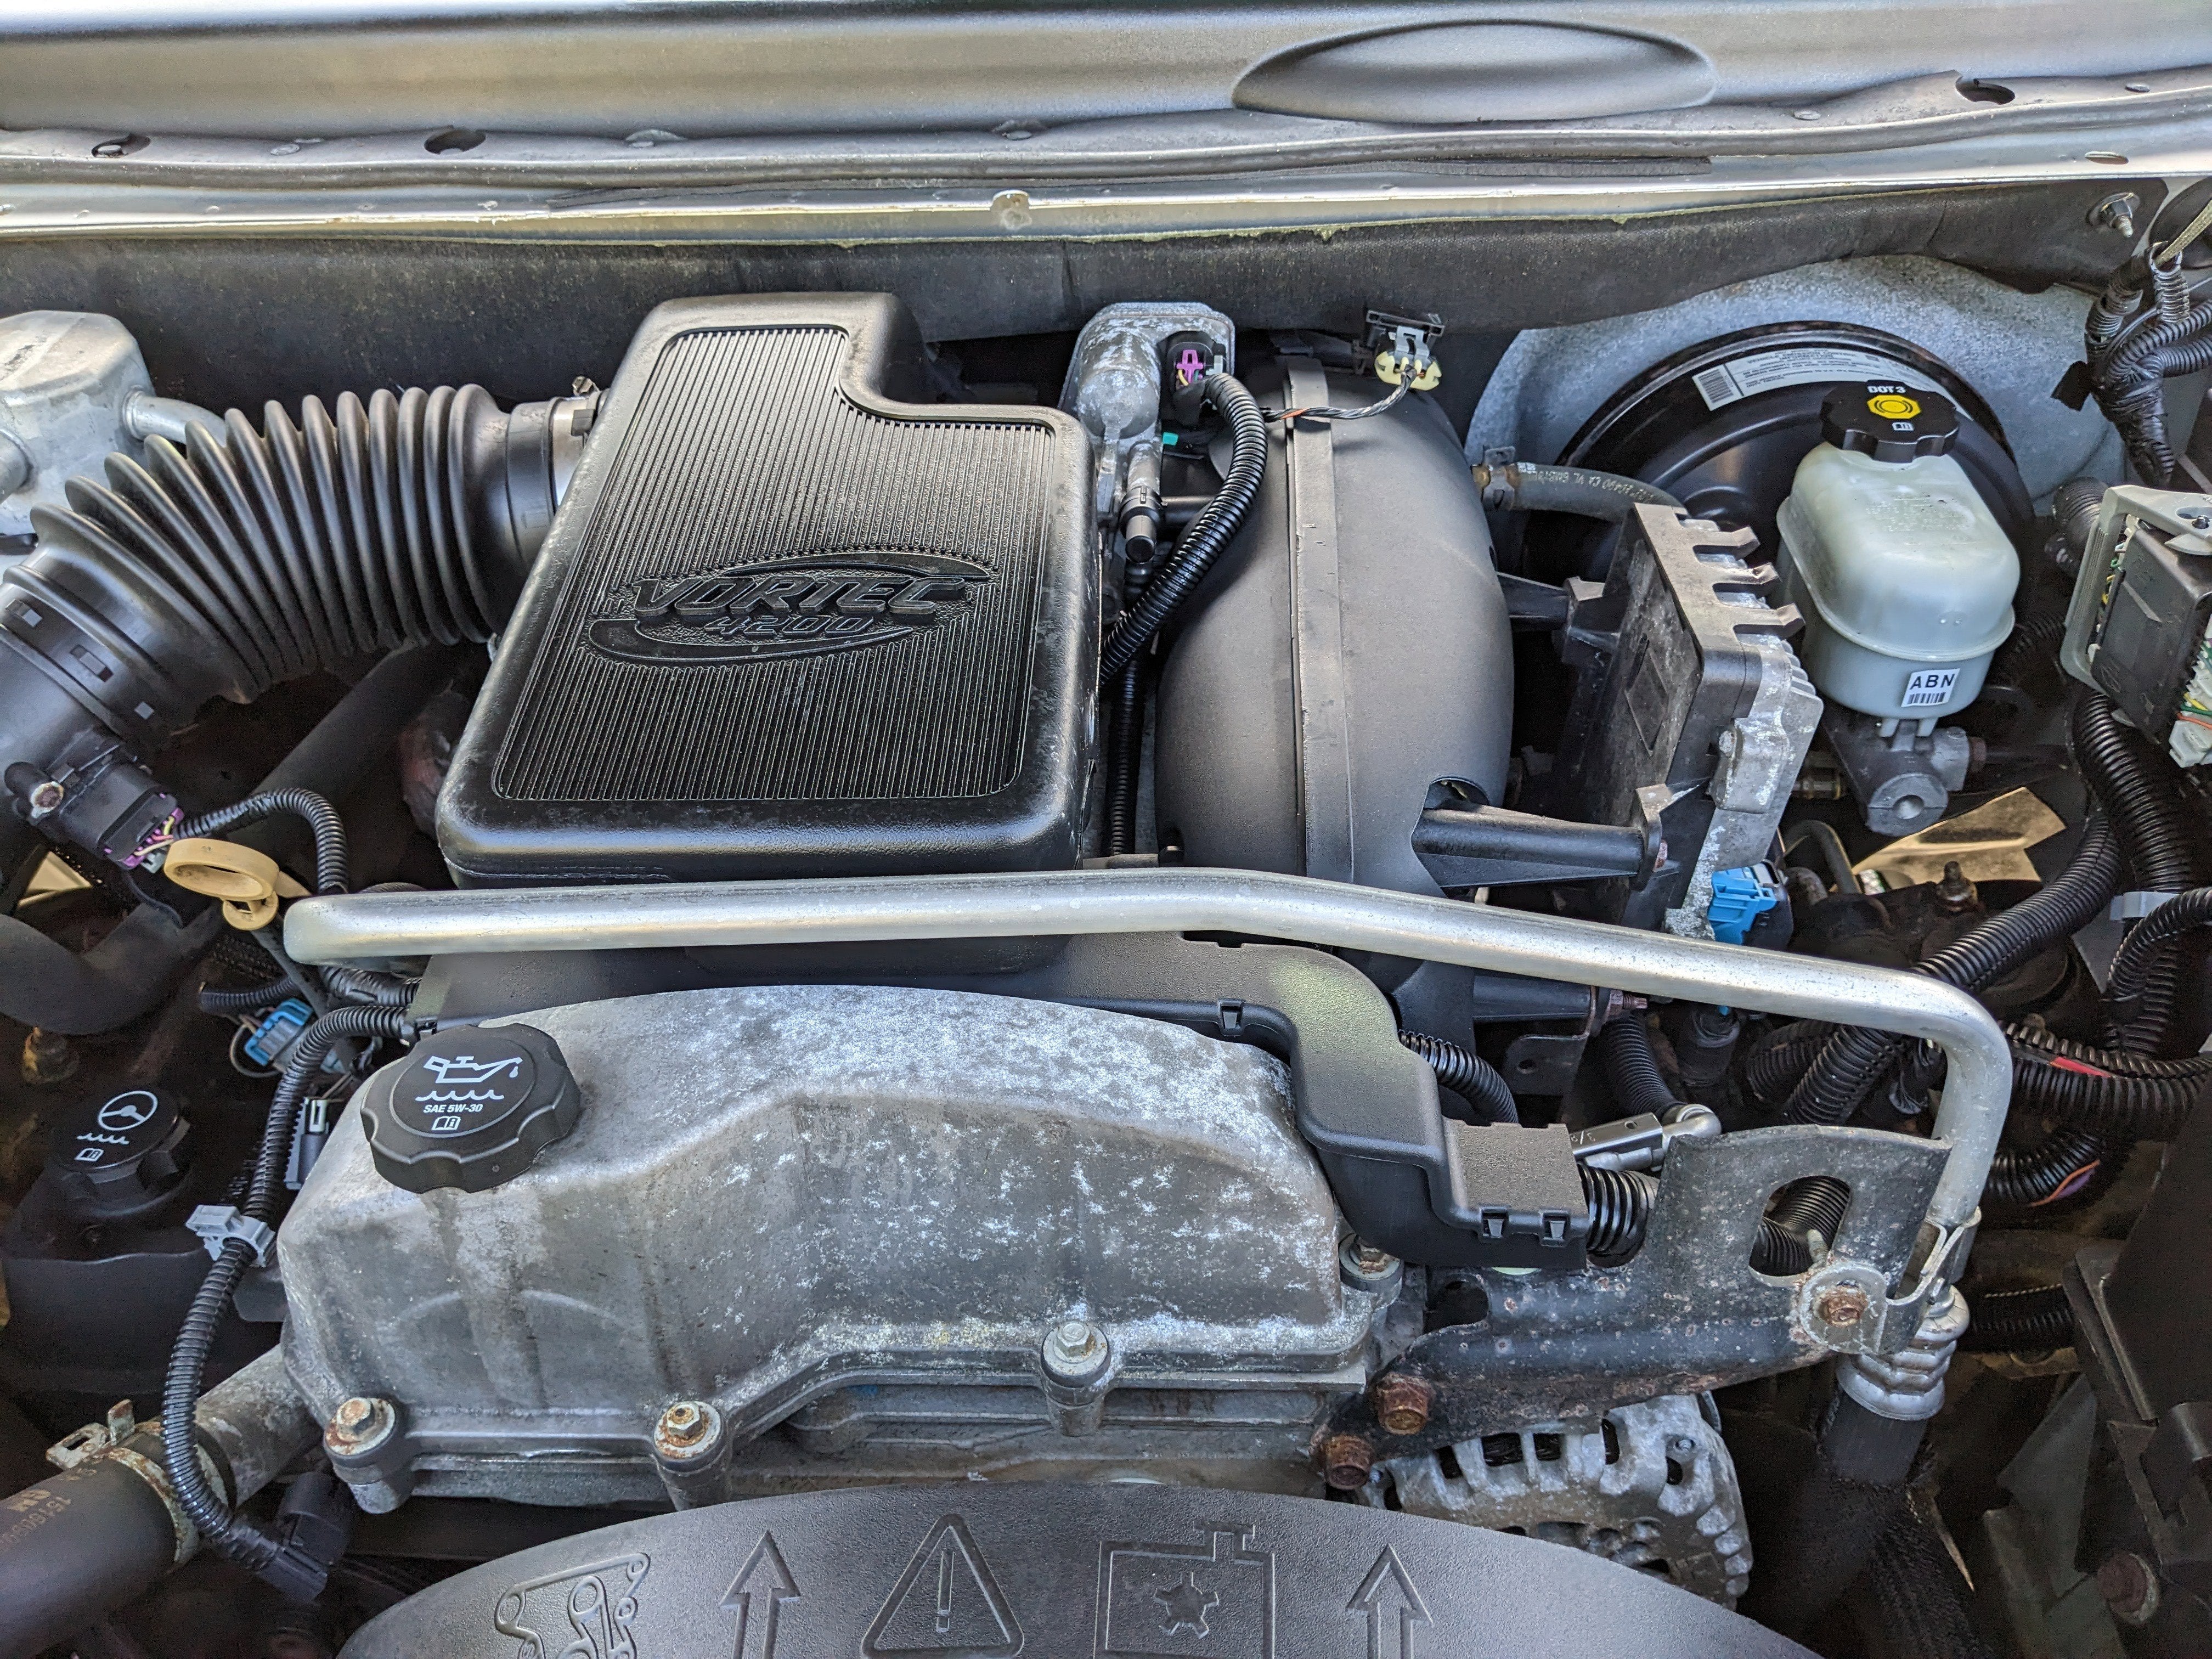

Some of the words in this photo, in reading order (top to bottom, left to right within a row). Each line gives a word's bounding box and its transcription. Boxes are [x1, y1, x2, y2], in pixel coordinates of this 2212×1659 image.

[633, 575, 965, 614] VORTEC
[705, 616, 874, 636] 4200
[1909, 674, 1955, 690] ABN
[423, 1104, 447, 1113] SAE
[447, 1104, 483, 1113] 5W-30
